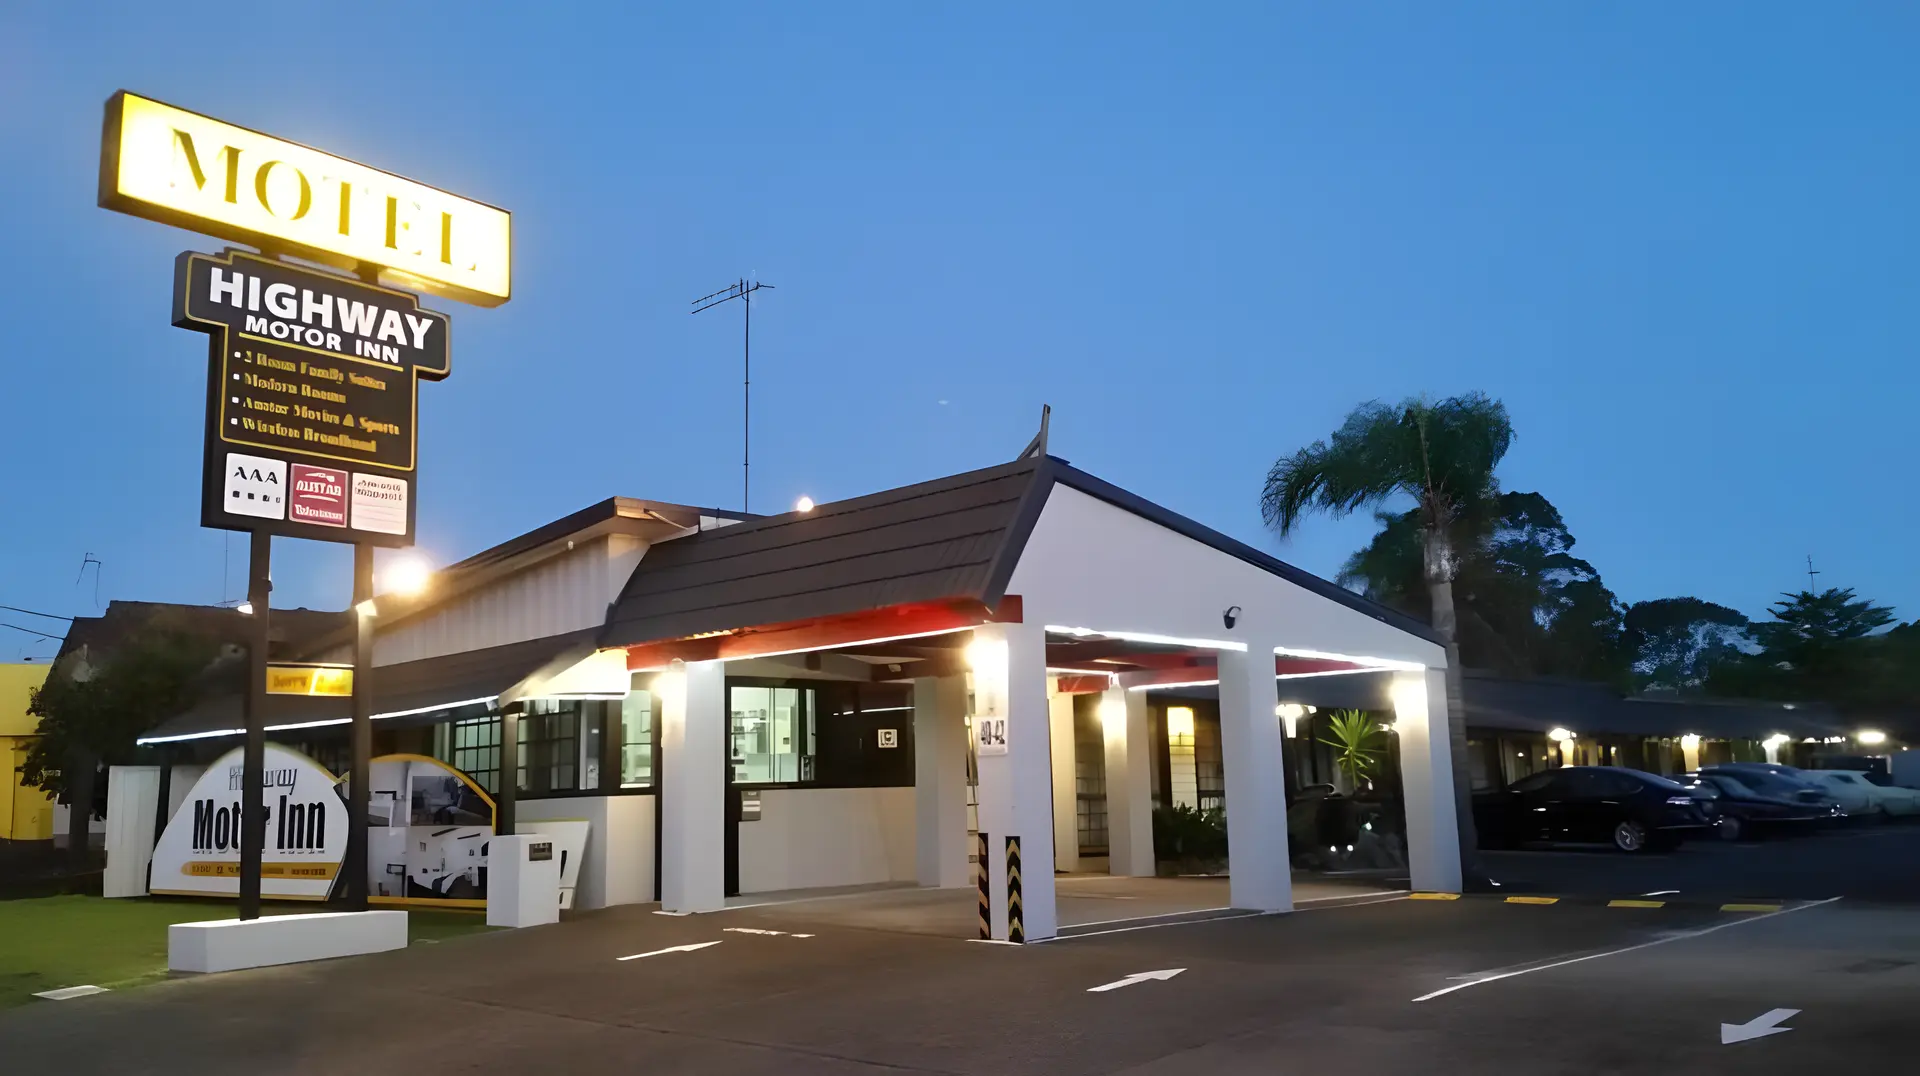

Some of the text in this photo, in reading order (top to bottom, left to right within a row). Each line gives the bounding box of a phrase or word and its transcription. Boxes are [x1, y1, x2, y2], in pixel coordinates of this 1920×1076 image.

[170, 128, 477, 272] MOTEL
[209, 266, 434, 350] HIGHWAY
[245, 314, 399, 364] MOTOR INN
[233, 466, 279, 485] AAA
[277, 795, 326, 850] Inn
